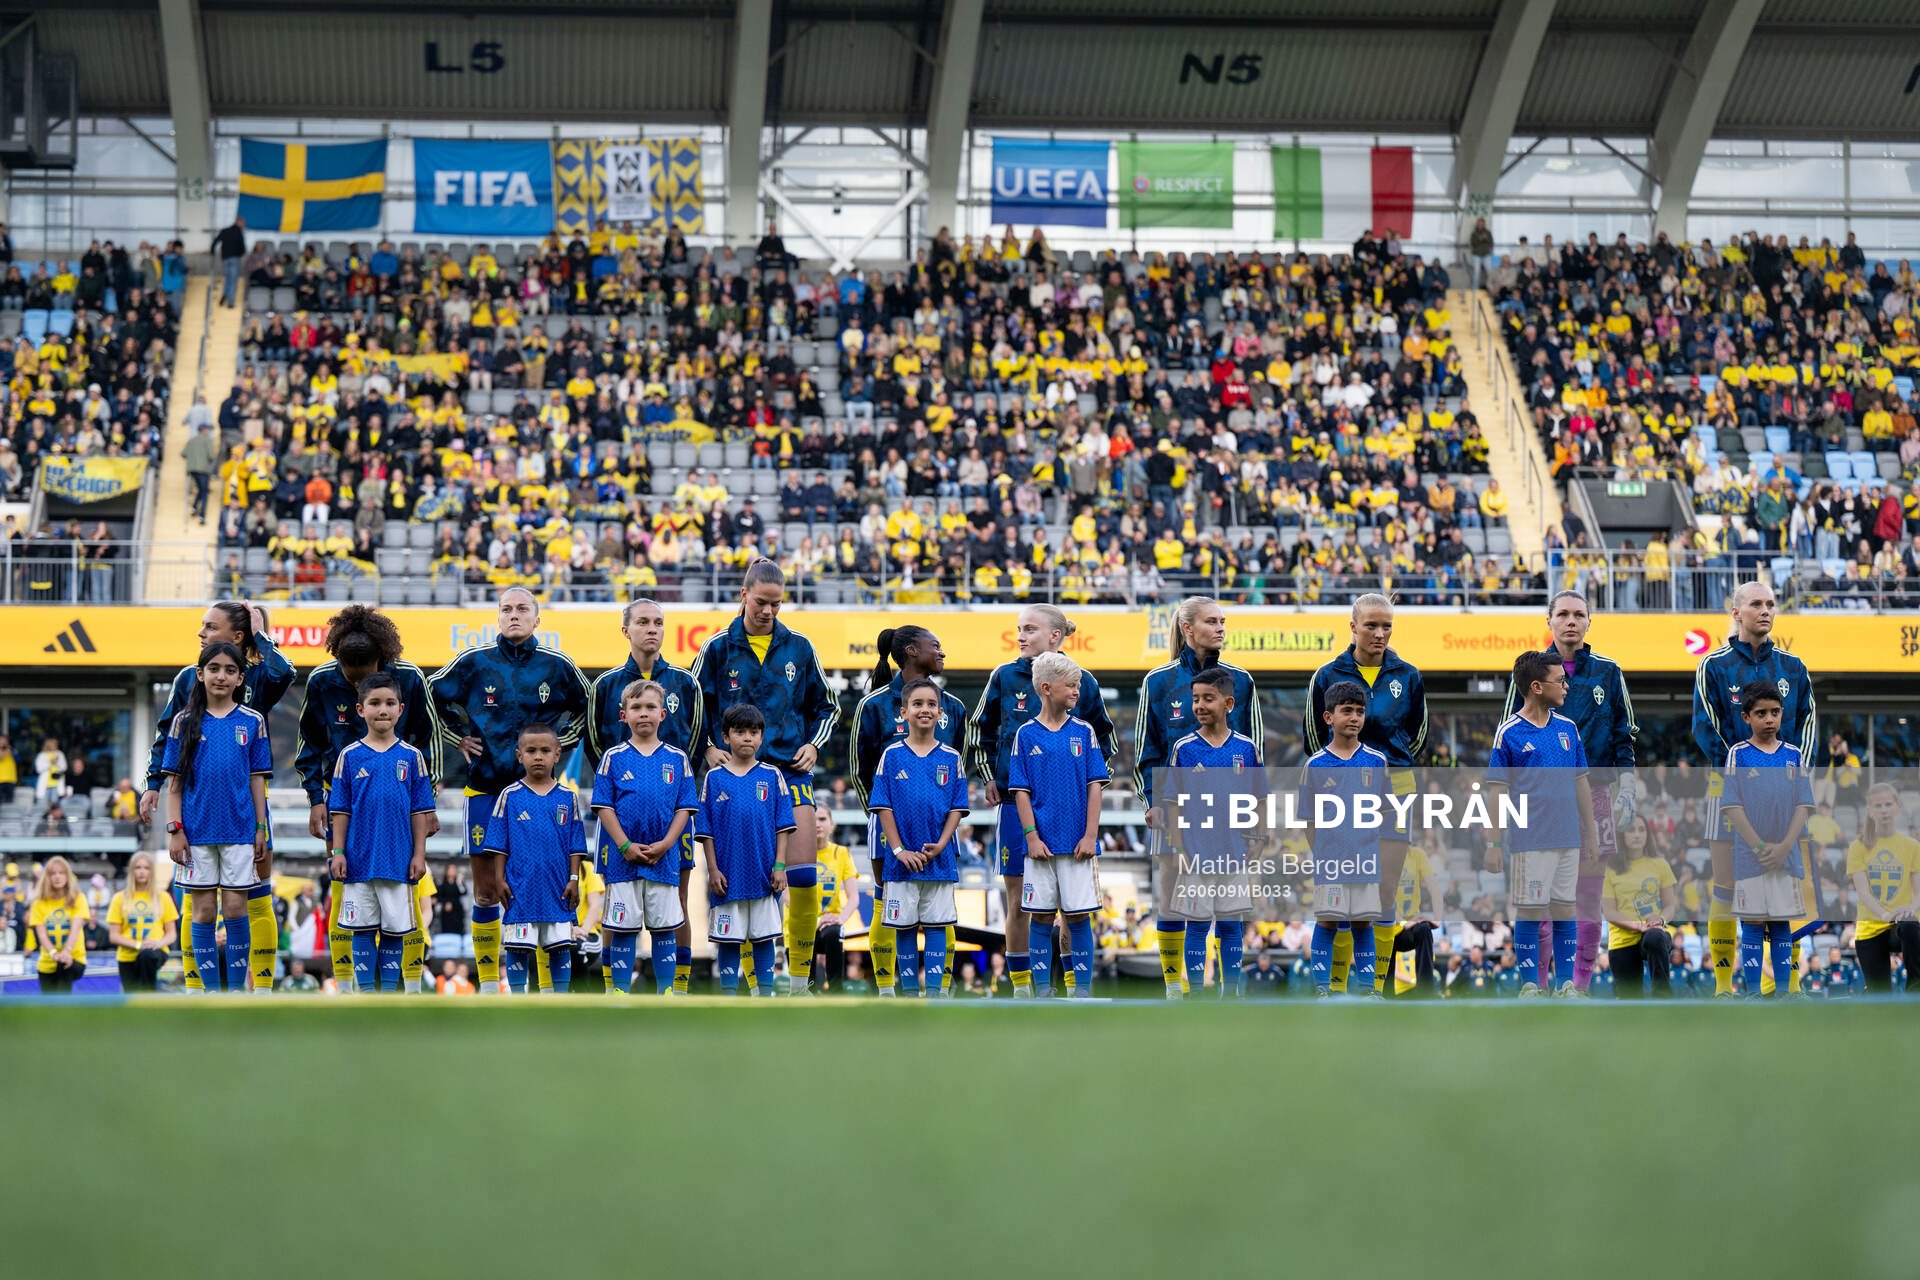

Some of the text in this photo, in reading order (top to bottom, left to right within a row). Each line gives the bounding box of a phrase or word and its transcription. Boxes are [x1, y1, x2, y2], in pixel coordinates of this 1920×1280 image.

[424, 42, 505, 73] L5
[1179, 52, 1263, 84] N5
[434, 170, 538, 207] FIFA
[996, 167, 1104, 200] UEFA
[1154, 176, 1223, 193] RESPECT
[1442, 632, 1538, 650] Swedbank
[790, 783, 815, 805] 14
